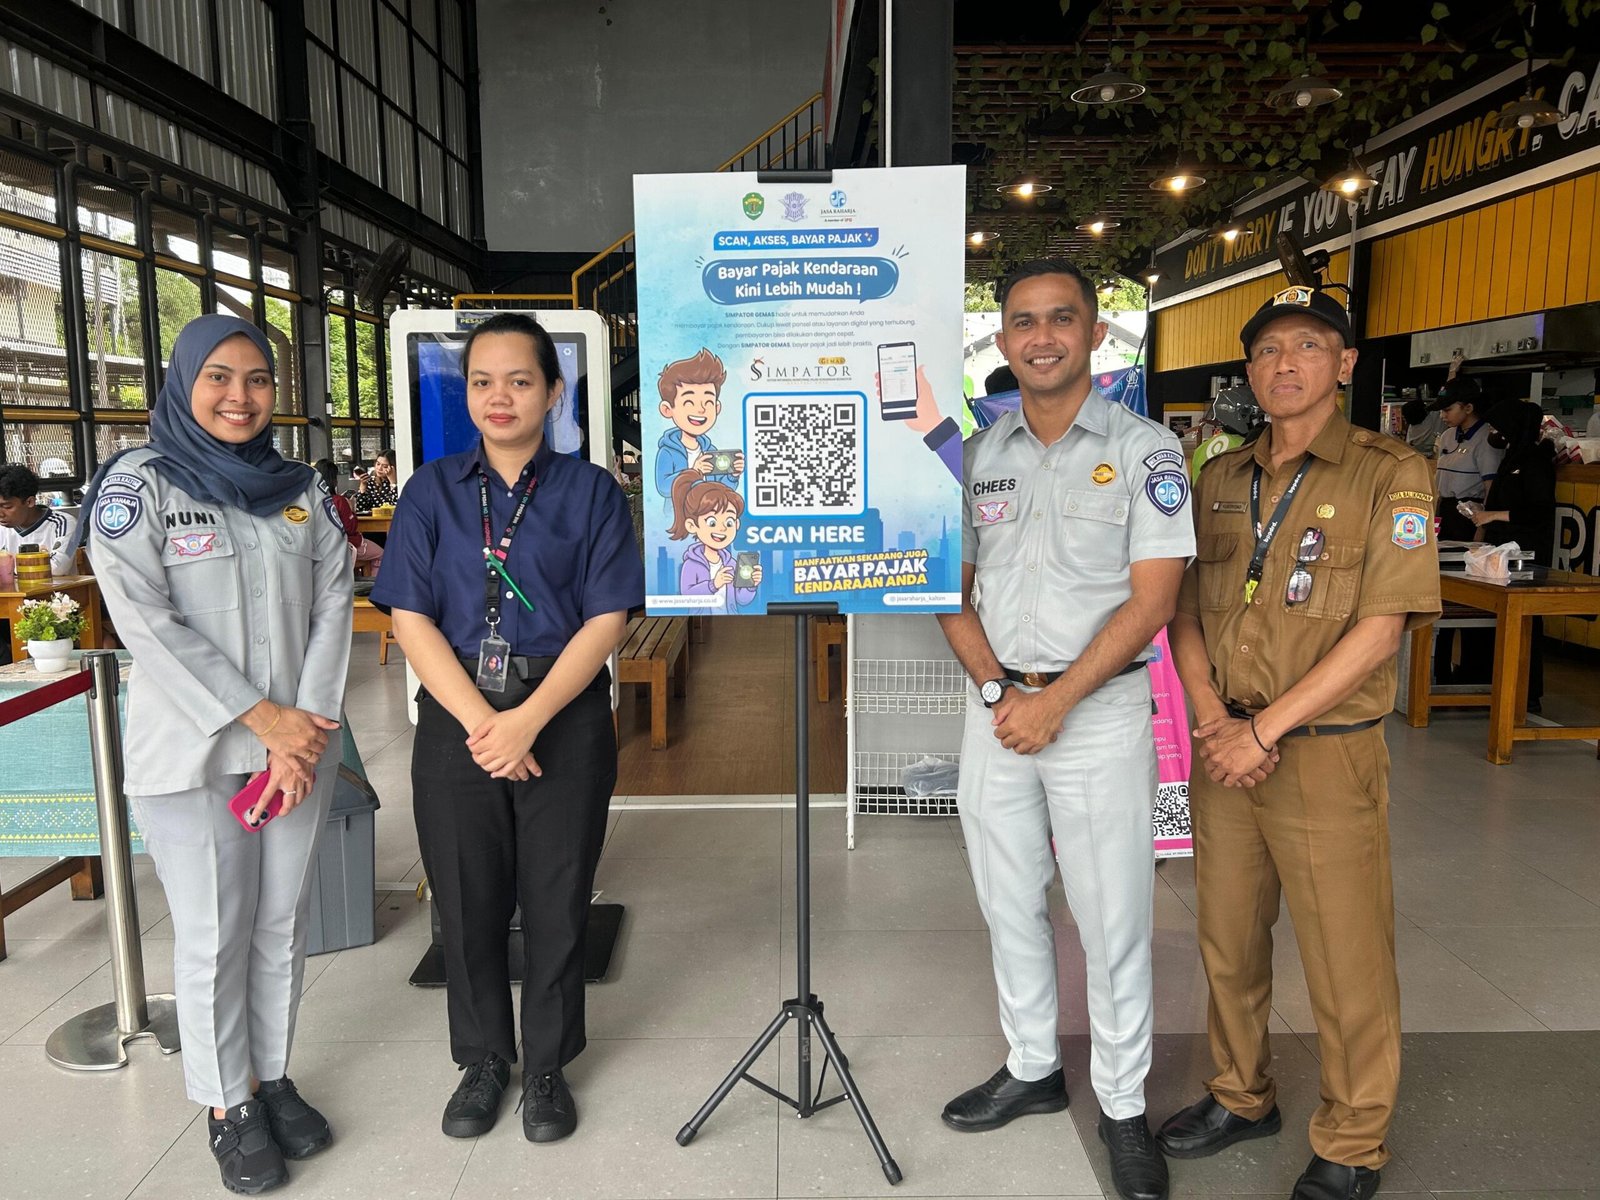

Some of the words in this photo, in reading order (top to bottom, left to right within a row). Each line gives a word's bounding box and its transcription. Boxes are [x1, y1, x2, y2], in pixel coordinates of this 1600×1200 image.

[1278, 201, 1296, 236] IF
[1303, 187, 1341, 238] YOU
[718, 235, 751, 247] SCAN,
[753, 235, 789, 246] AKSES,
[791, 234, 825, 245] BAYAR
[828, 233, 862, 244] PAJAK
[718, 265, 758, 280] Bayar
[762, 260, 800, 278] Pajak
[803, 261, 878, 276] Kendaraan
[735, 282, 761, 298] Kini
[765, 281, 802, 296] Lebih
[806, 281, 853, 296] Mudah
[856, 282, 861, 295] !
[750, 363, 851, 381] SIMPATOR
[973, 478, 1017, 496] CHEES
[165, 511, 216, 529] NUNI
[746, 526, 803, 544] SCAN
[810, 525, 865, 543] HERE
[794, 555, 856, 567] MANFAATKAN
[856, 551, 903, 562] SEKARANG
[903, 550, 928, 558] JUGA
[794, 563, 860, 582] BAYAR
[863, 558, 928, 576] PAJAK
[794, 576, 883, 594] KENDARAAN
[885, 573, 928, 588] ANDA
